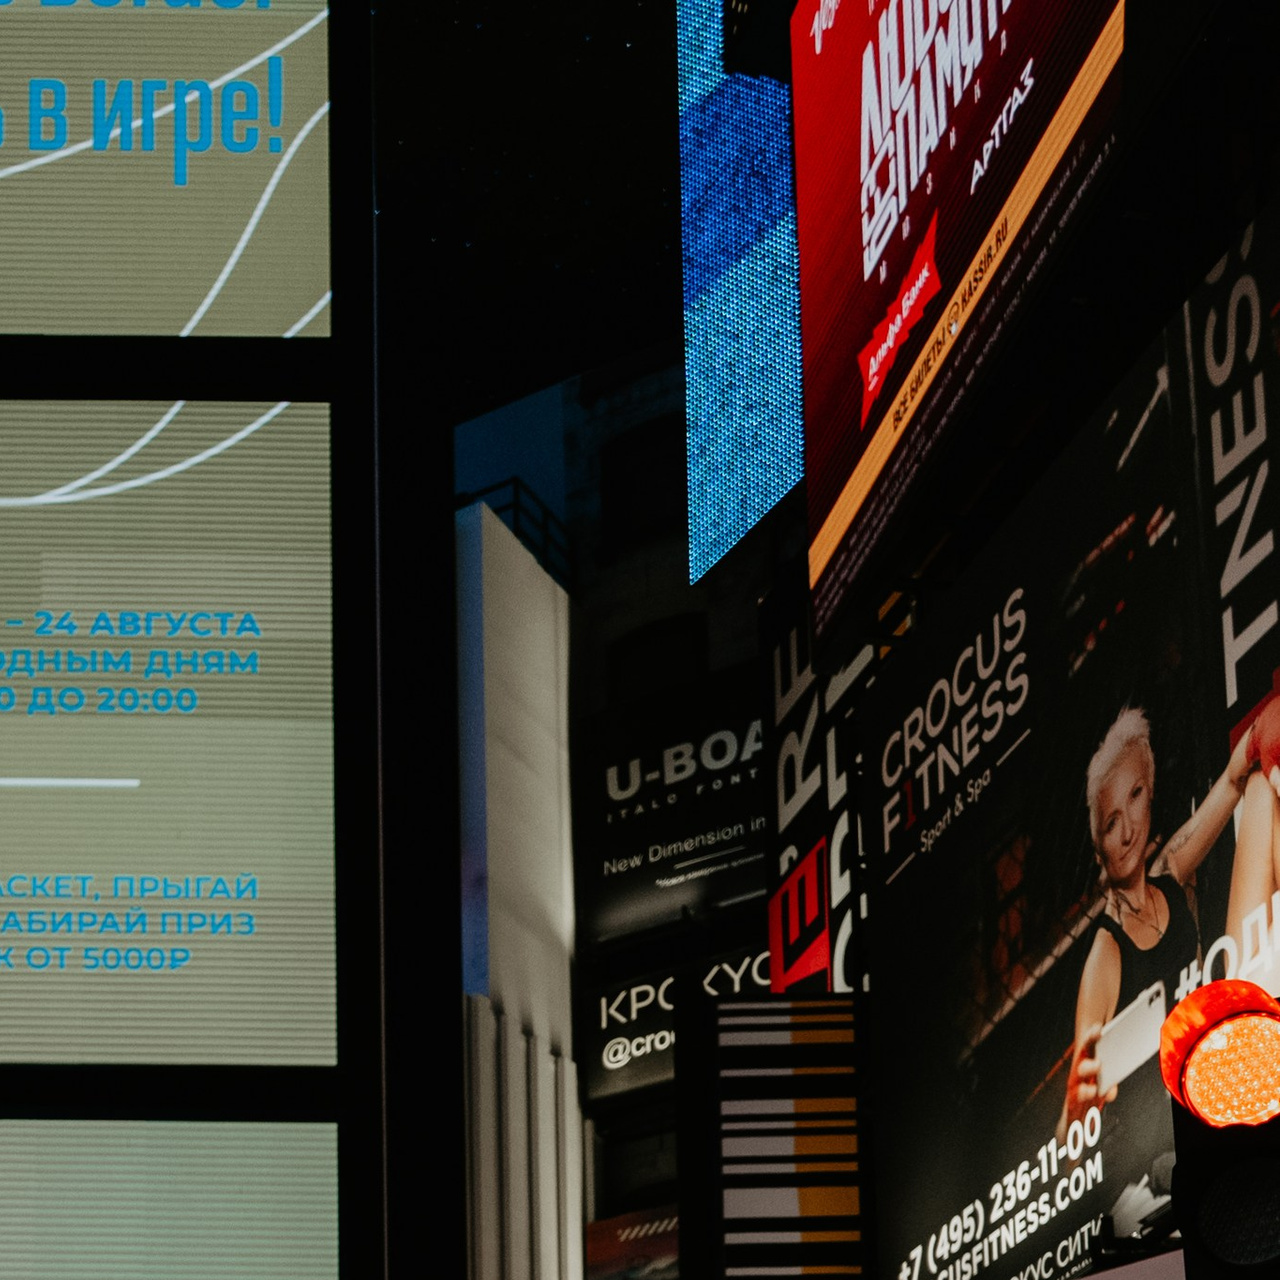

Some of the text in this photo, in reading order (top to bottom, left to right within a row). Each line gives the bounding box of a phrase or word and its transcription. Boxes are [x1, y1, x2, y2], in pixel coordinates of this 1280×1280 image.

[28, 78, 68, 151] в
[91, 55, 283, 186] игре!
[970, 57, 1034, 195] АРТГАЗ
[892, 391, 908, 432] ВСЕ
[909, 327, 946, 396] БИЛЕТЫ
[961, 217, 1008, 313] KASSIR.RU
[34, 611, 77, 638] 24
[89, 611, 261, 639] АВГУСТА
[145, 650, 259, 679] ДНЯМ
[881, 587, 1027, 788] CROCUS
[26, 687, 85, 716] ДО
[96, 687, 198, 714] 20:00
[602, 852, 643, 877] New
[648, 822, 746, 865] Dimension
[750, 815, 767, 833] in
[920, 768, 992, 853] Sport & Spa
[112, 872, 258, 901] ПРЫГАЙ
[26, 946, 71, 970] ОТ
[159, 912, 255, 936] ПРИЗ
[1173, 888, 1280, 1000] #ОД
[927, 1199, 984, 1275] (495)
[989, 1106, 1102, 1223] 236-11-00
